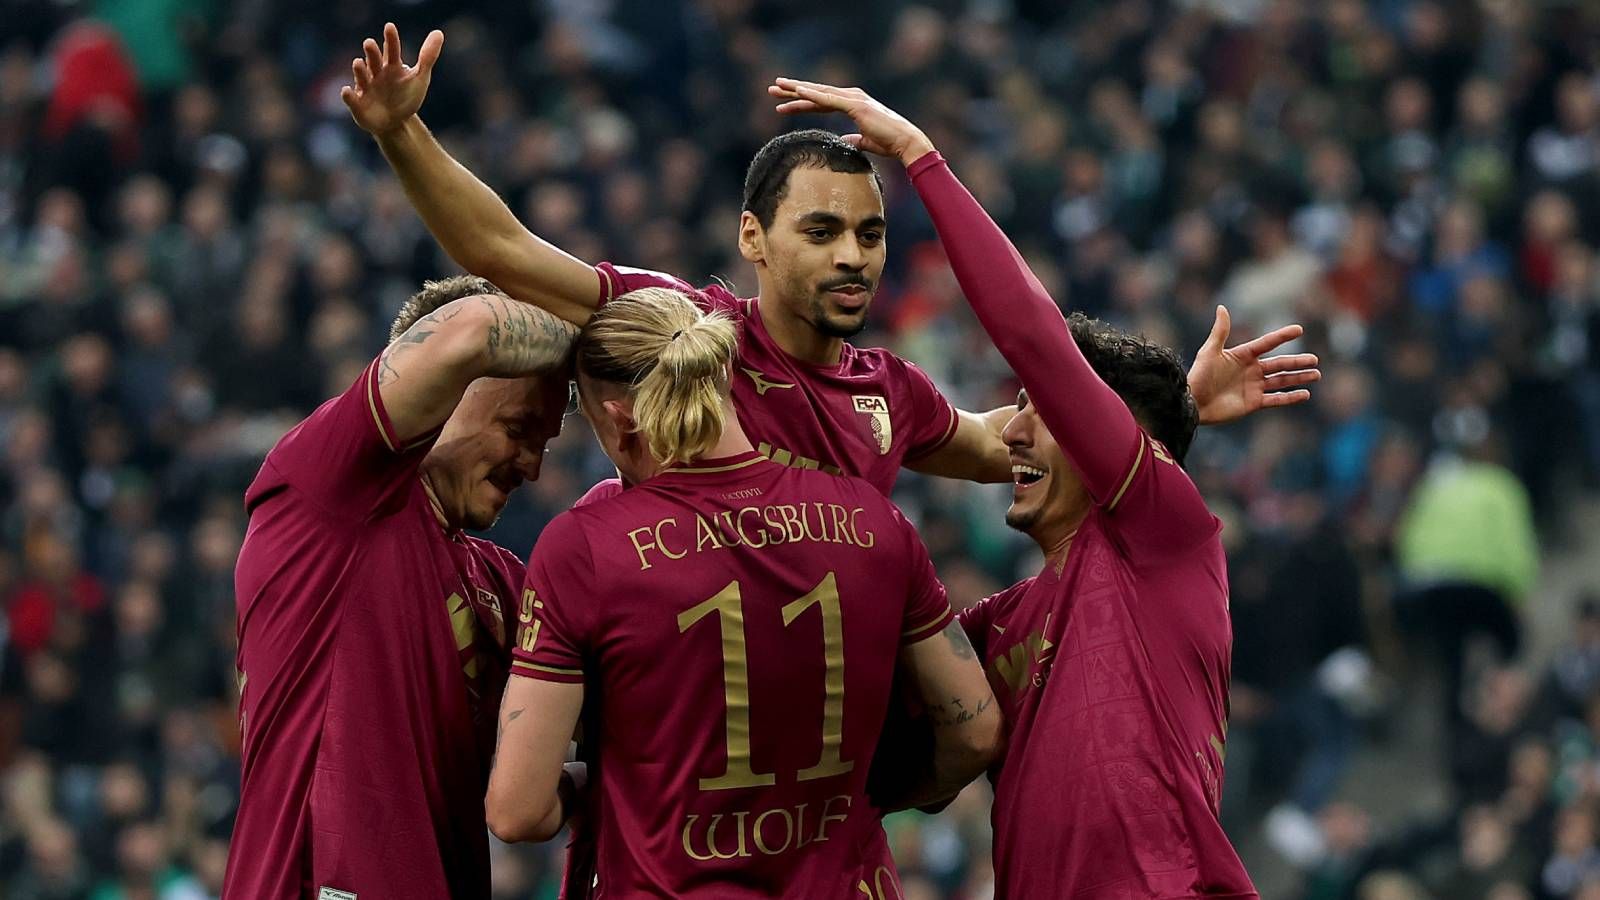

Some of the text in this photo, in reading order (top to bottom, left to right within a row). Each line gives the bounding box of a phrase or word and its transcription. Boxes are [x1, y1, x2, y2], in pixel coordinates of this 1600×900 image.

[856, 398, 885, 411] FCA
[627, 502, 874, 570] FC AUGSBURG
[677, 571, 854, 790] 11
[682, 795, 852, 860] WOLF
